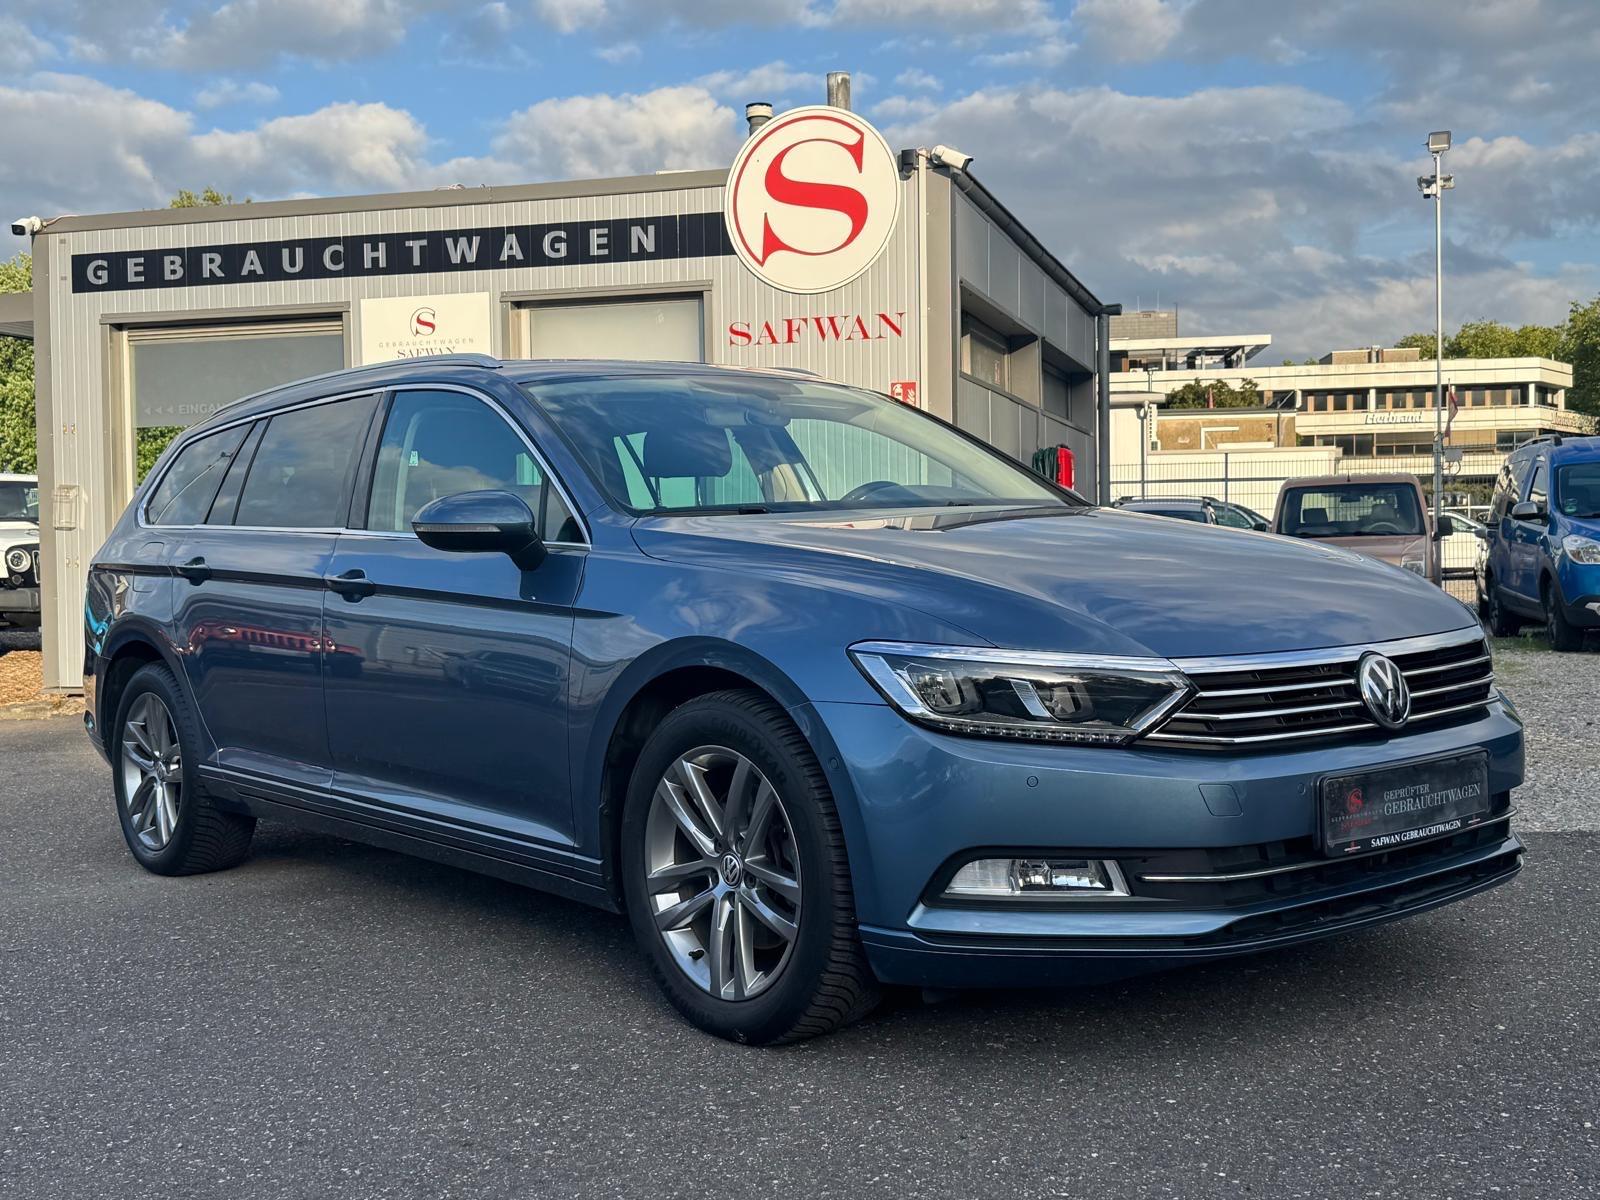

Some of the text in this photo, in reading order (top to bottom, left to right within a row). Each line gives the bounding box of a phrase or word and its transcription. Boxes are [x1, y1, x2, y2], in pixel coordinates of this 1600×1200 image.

[733, 115, 869, 268] S
[86, 224, 656, 285] GEBRAUCHTWAGEN
[378, 337, 474, 349] GEBRAUCHTWAGEN
[728, 311, 906, 348] SAFWAN
[1383, 783, 1430, 800] GEPRÜFTER
[1384, 783, 1481, 816] GEBRAUCHTWAGEN
[1370, 833, 1401, 848] SAFWAN
[1401, 819, 1462, 842] GEBRAUCHTWAGEN
